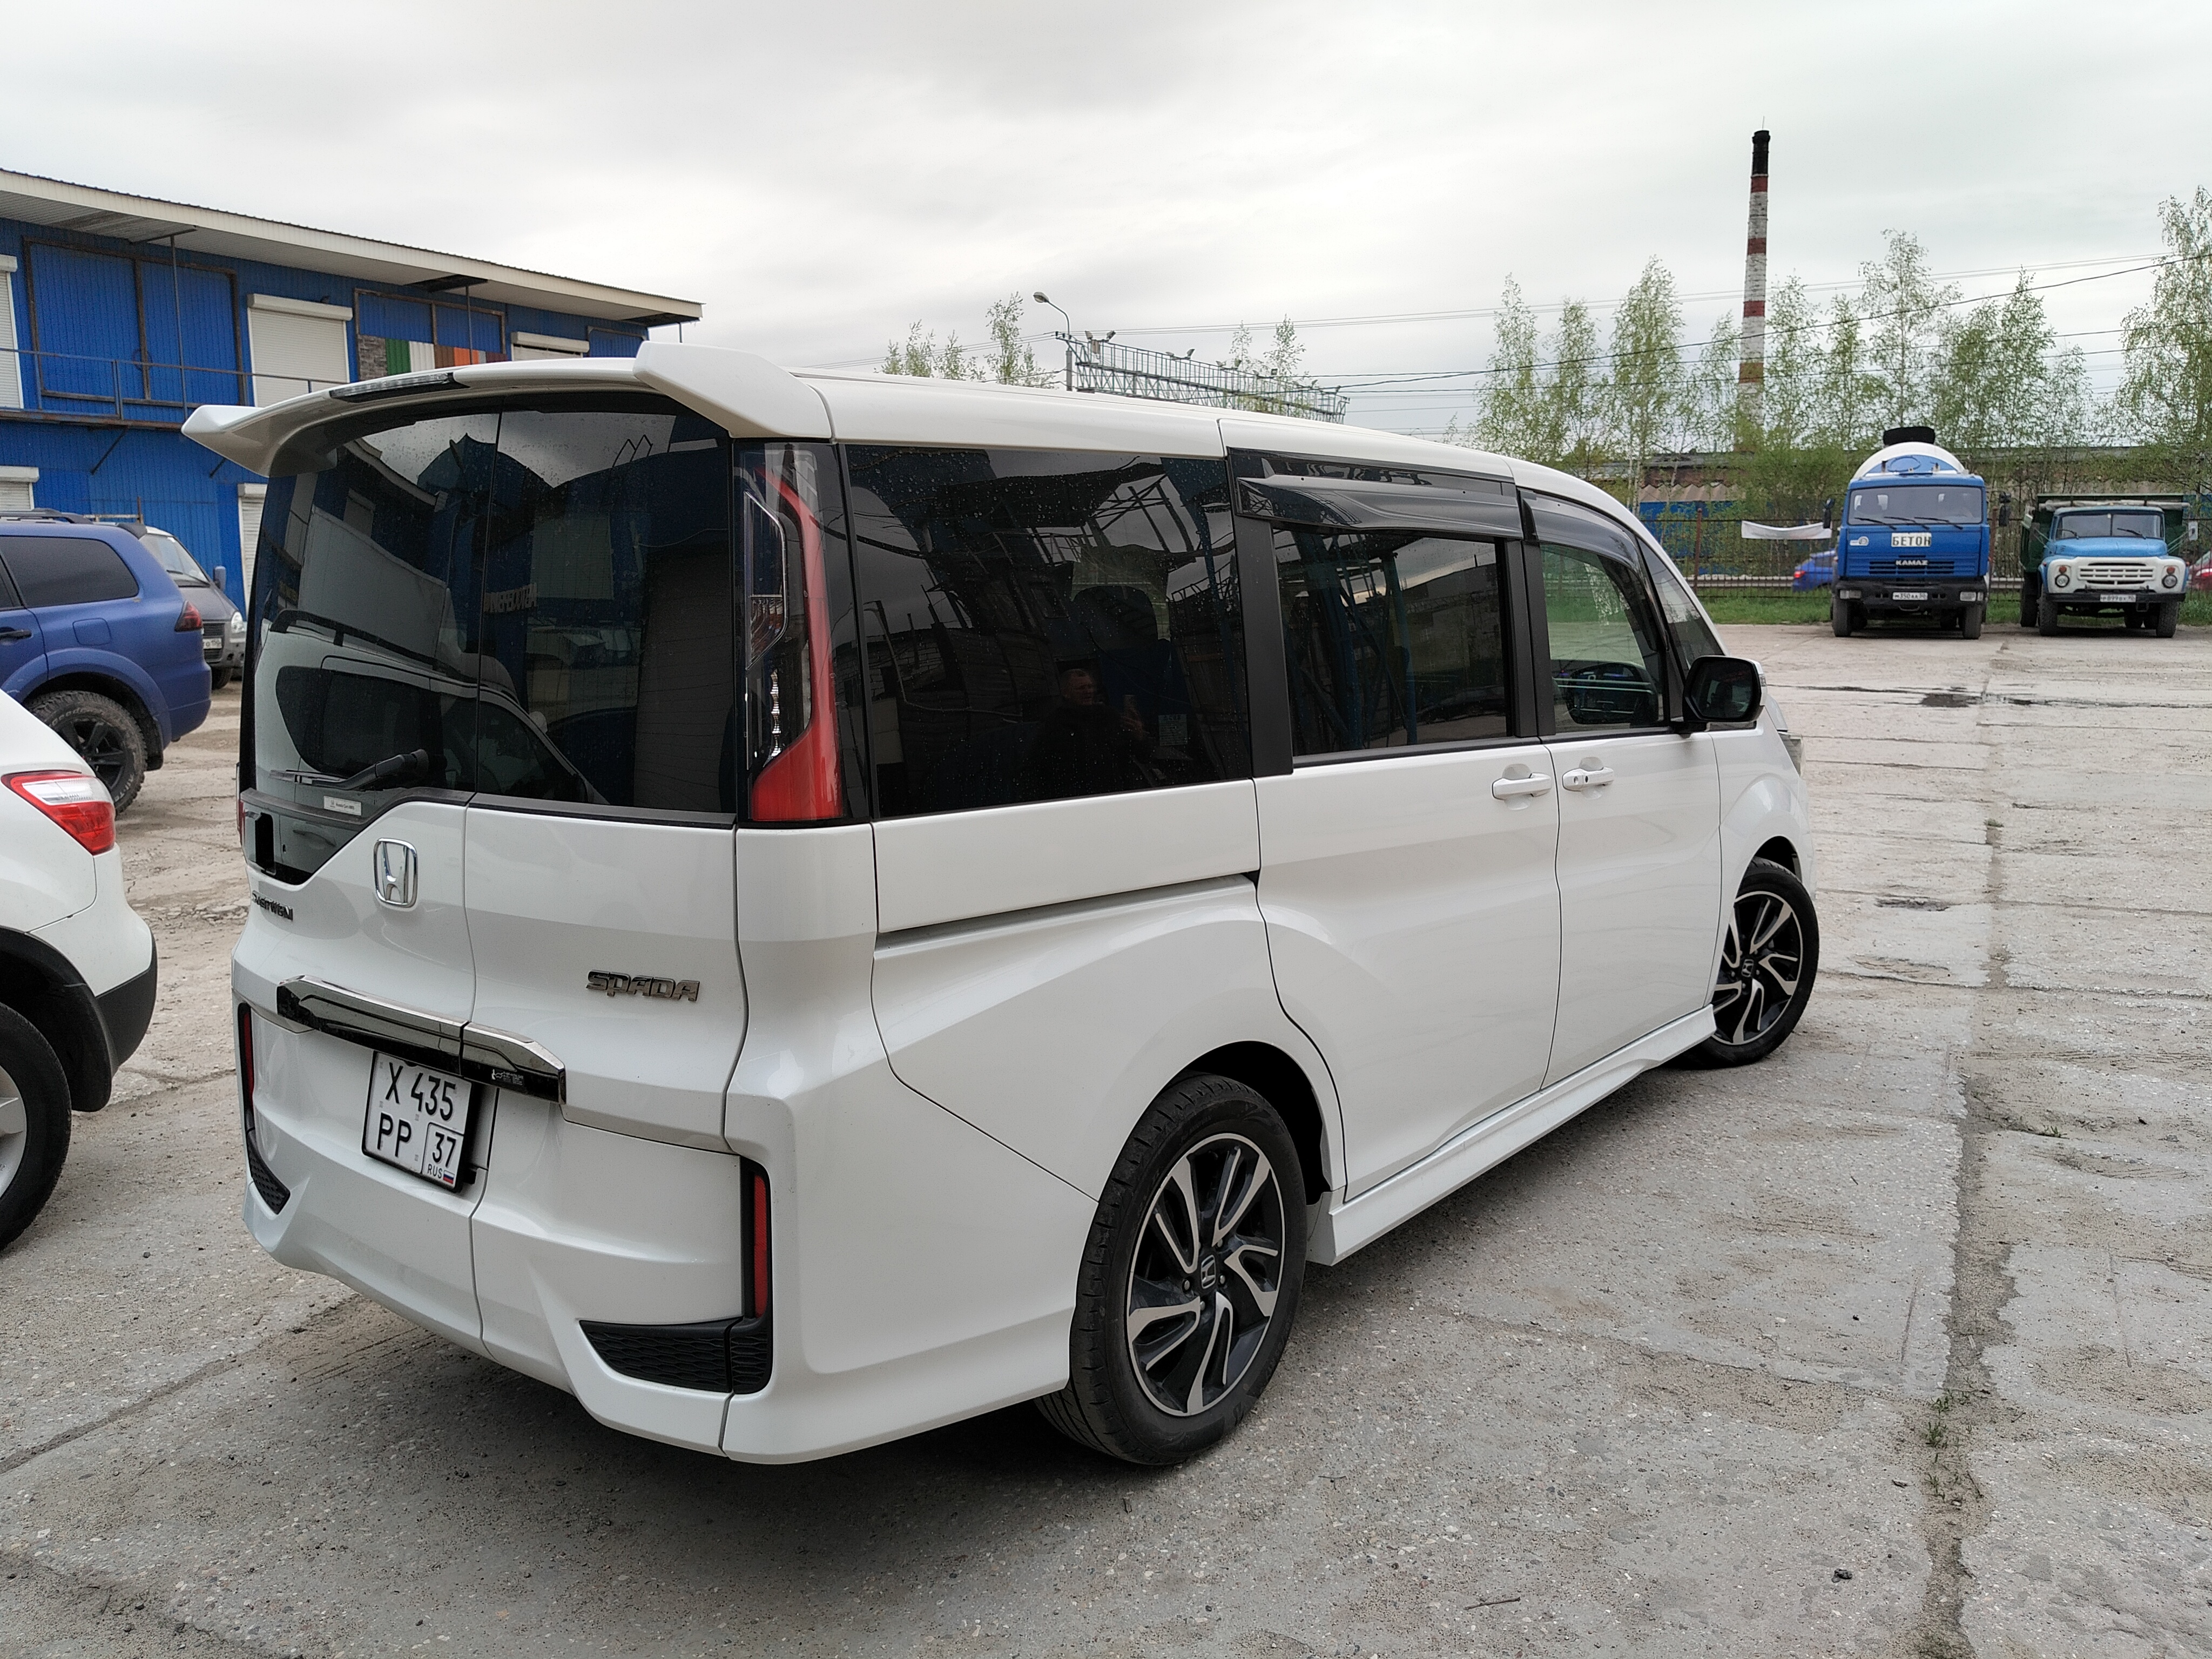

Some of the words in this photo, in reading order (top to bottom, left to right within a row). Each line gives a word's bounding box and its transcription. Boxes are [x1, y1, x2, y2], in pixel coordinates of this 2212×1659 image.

[1892, 536, 1931, 546] БЕТОН
[410, 1072, 456, 1122] 435
[432, 1131, 457, 1168] 37
[427, 1163, 442, 1179] RUS
